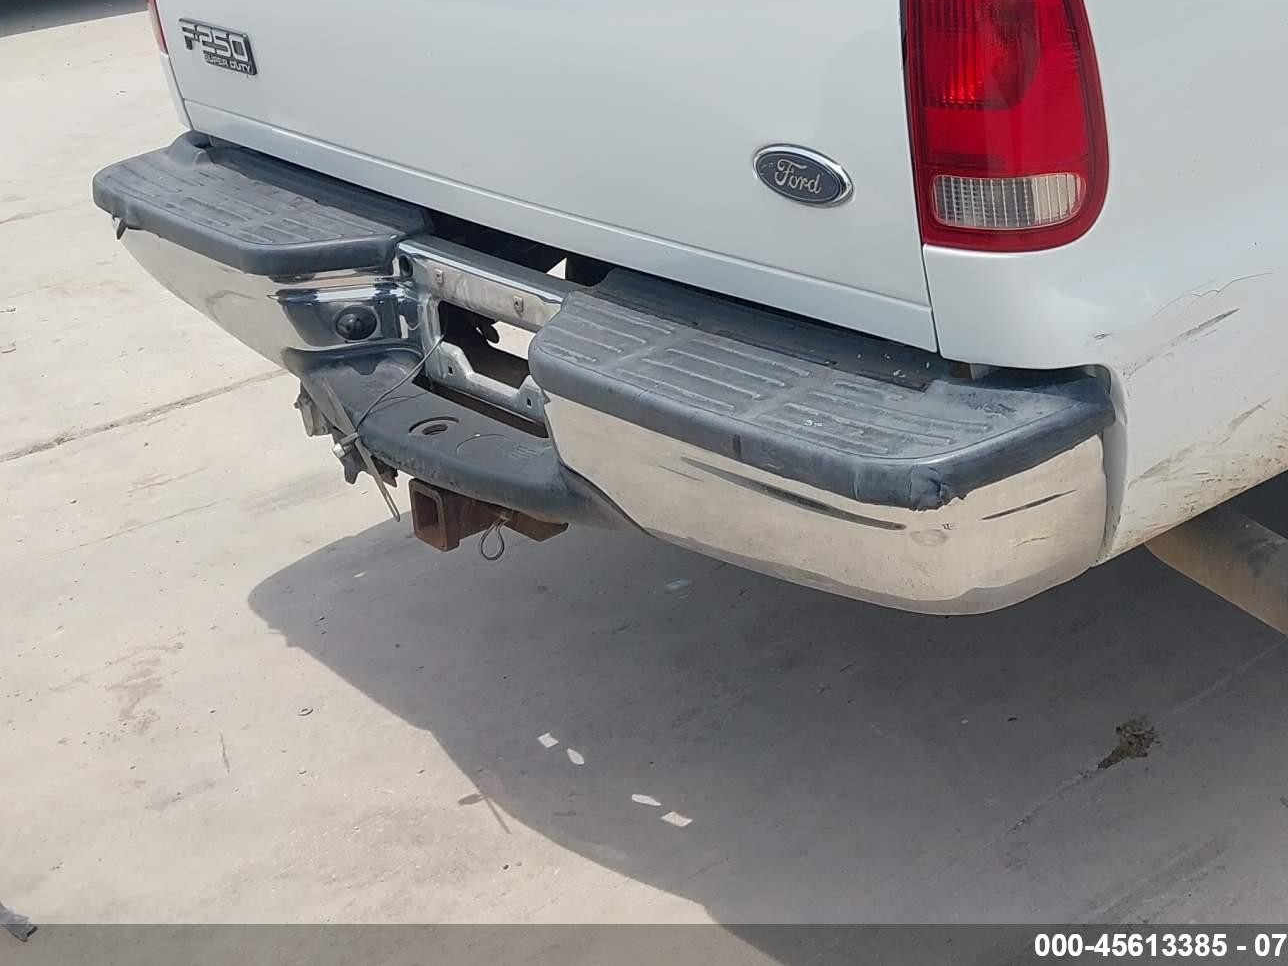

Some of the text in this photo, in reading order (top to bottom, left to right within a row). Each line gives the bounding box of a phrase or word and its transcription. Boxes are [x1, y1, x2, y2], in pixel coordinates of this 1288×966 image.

[181, 23, 248, 62] F250
[204, 54, 252, 74] SUPER DUTY
[774, 158, 822, 195] Ford
